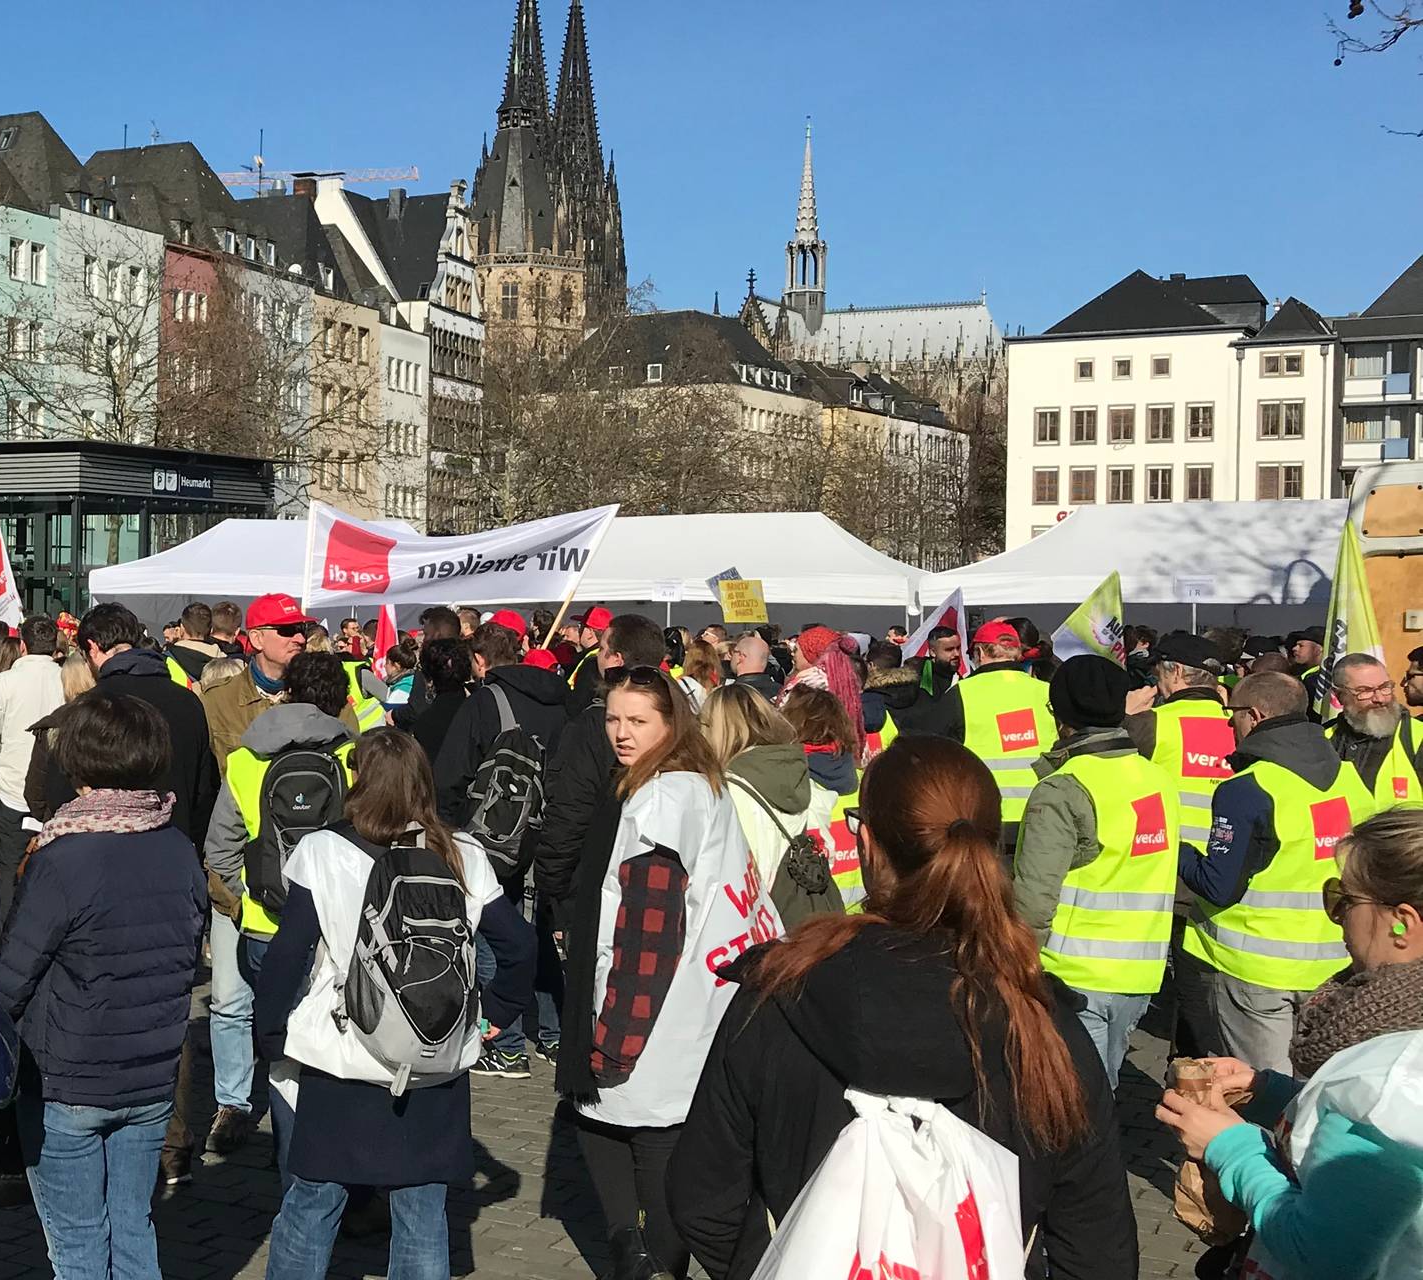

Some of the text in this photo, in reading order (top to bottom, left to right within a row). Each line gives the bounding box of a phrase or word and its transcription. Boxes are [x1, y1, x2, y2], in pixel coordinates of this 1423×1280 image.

[181, 476, 211, 489] Heumarkt
[1002, 729, 1036, 743] ver.di
[1187, 751, 1232, 770] ver.d
[1135, 828, 1166, 845] ver.di
[825, 845, 859, 861] er.d
